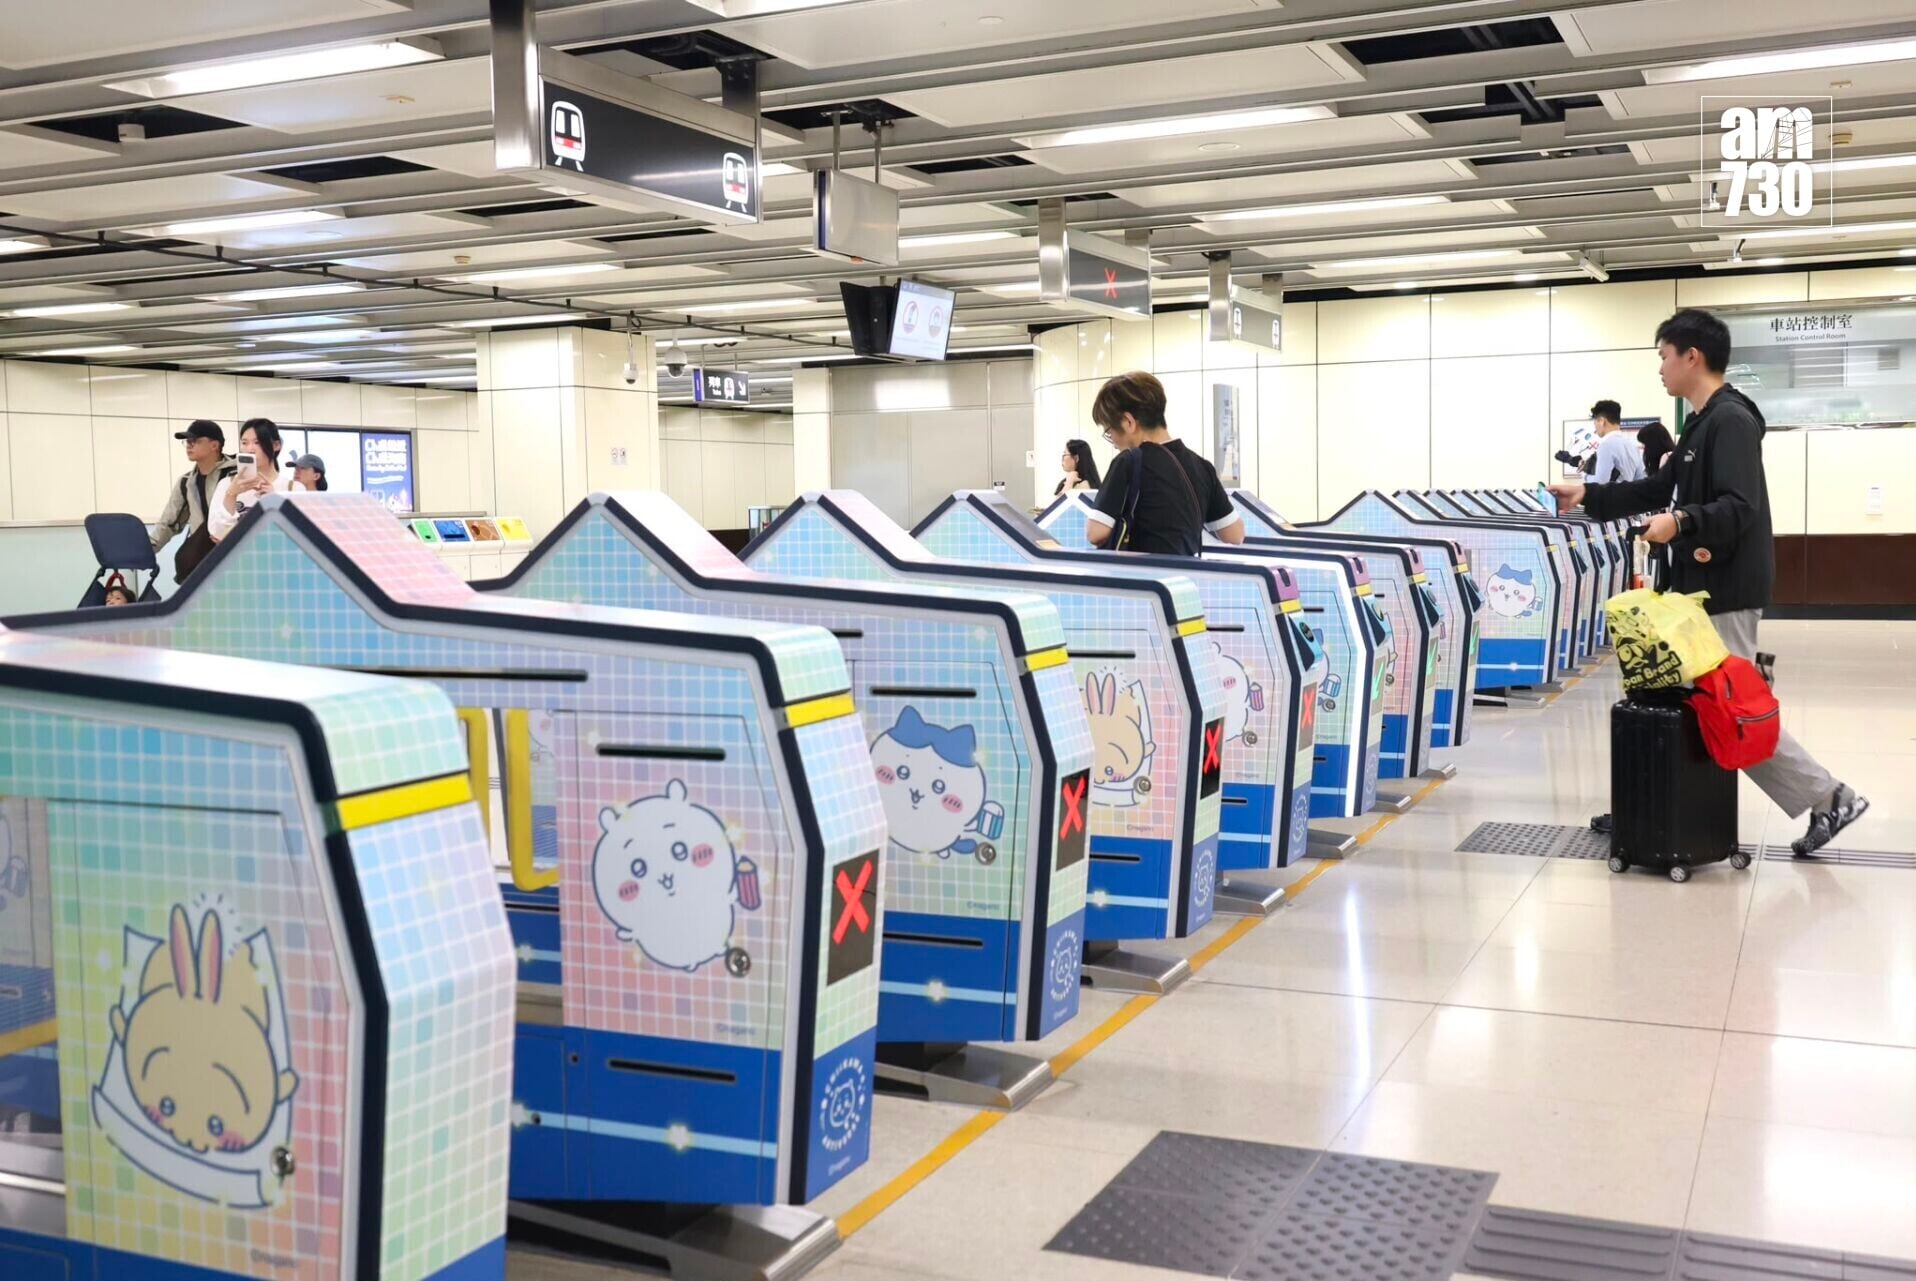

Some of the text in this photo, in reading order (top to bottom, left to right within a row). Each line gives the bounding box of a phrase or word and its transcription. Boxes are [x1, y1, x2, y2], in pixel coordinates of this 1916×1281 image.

[1770, 314, 1853, 333] 車站控制室
[1800, 333, 1825, 341] Control
[1643, 652, 1680, 679] Brand
